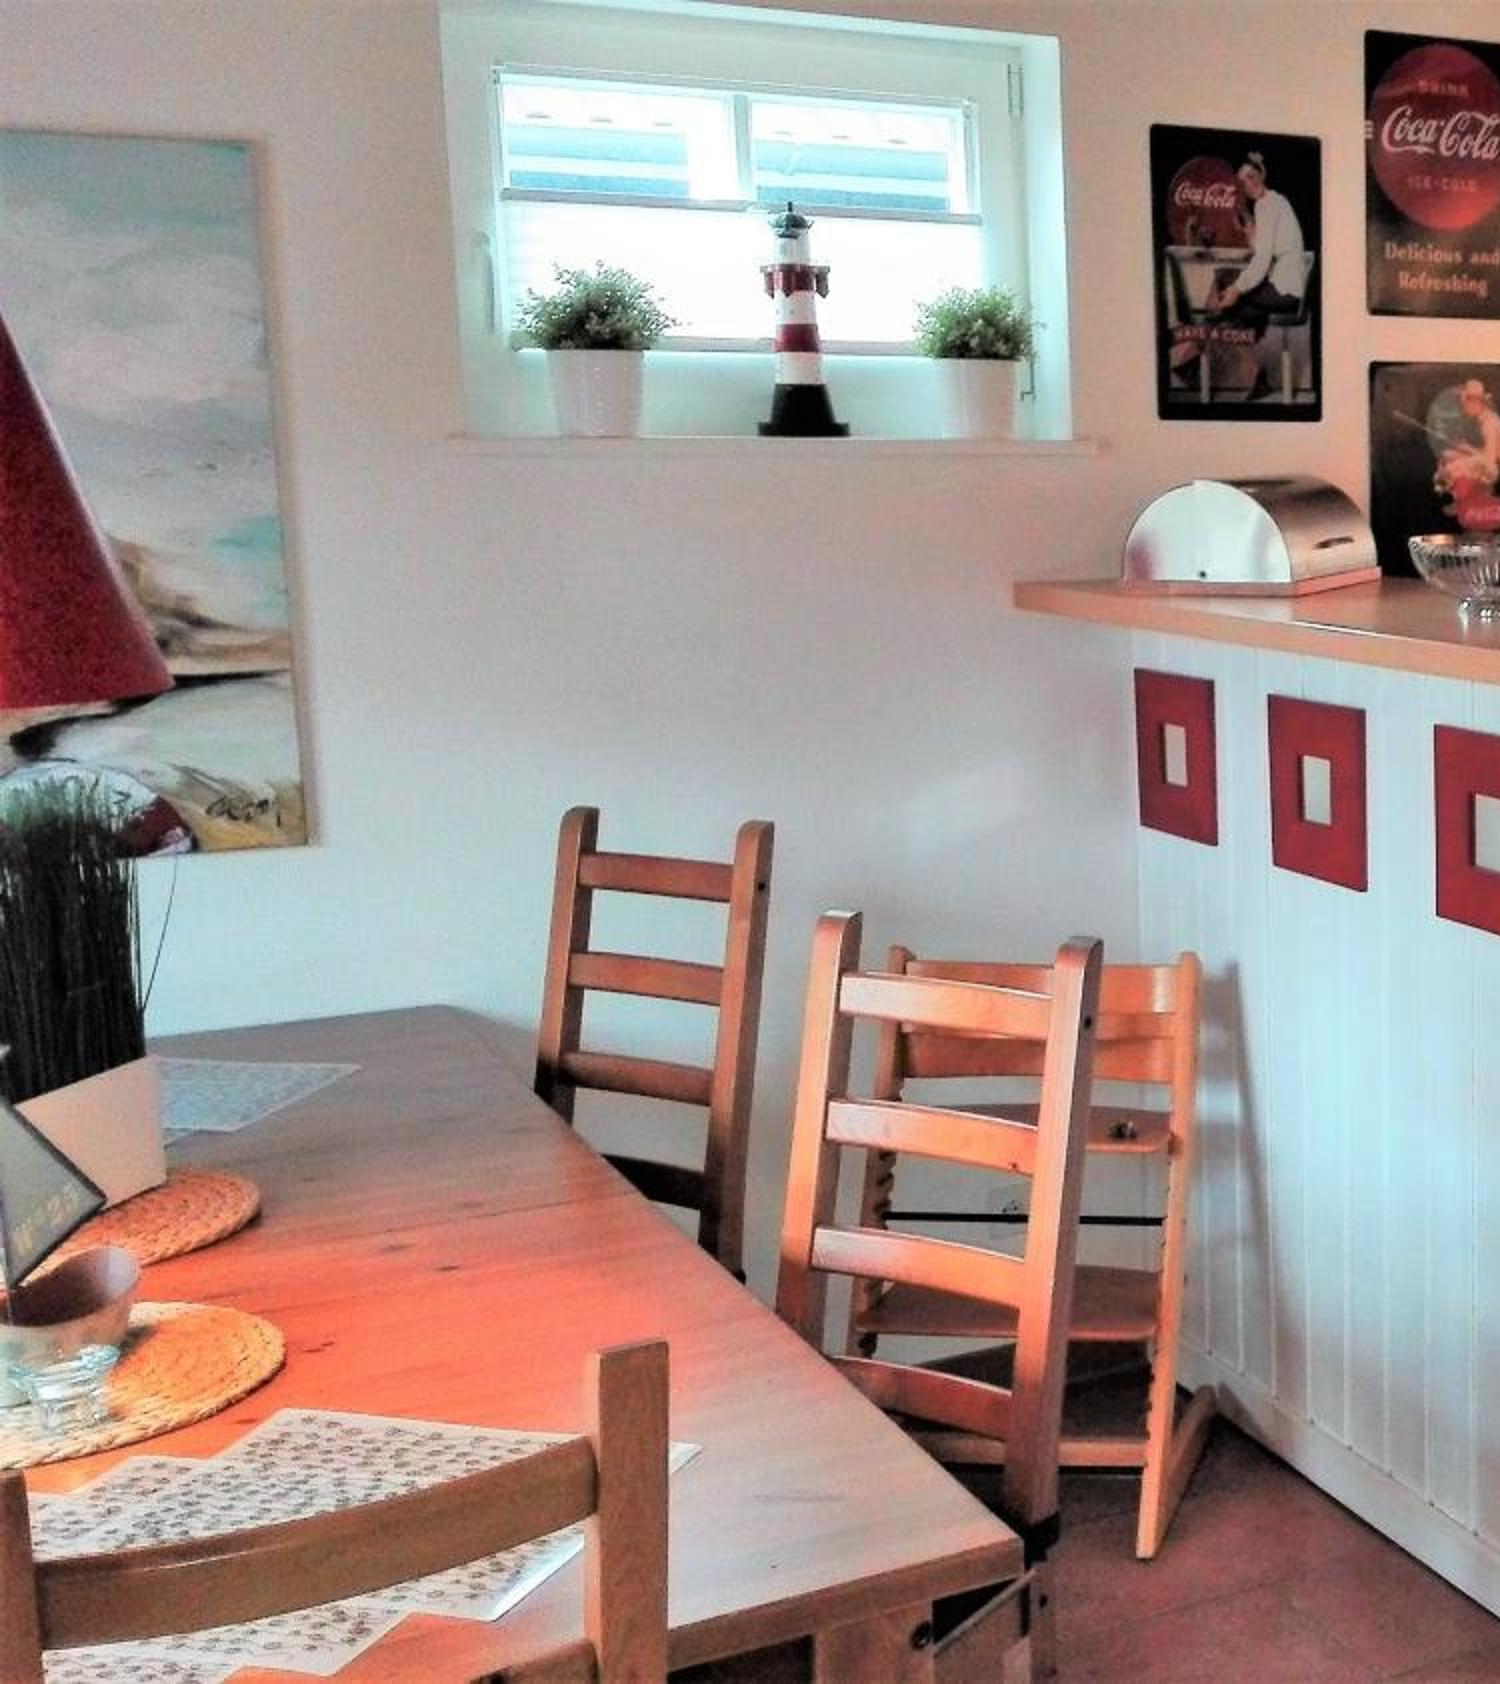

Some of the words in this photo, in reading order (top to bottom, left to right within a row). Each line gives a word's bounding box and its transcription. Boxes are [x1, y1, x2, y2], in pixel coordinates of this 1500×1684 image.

[1416, 79, 1470, 97] DRINK
[1384, 241, 1462, 265] Delicious
[1470, 247, 1500, 266] and
[1398, 270, 1488, 298] Refreshing
